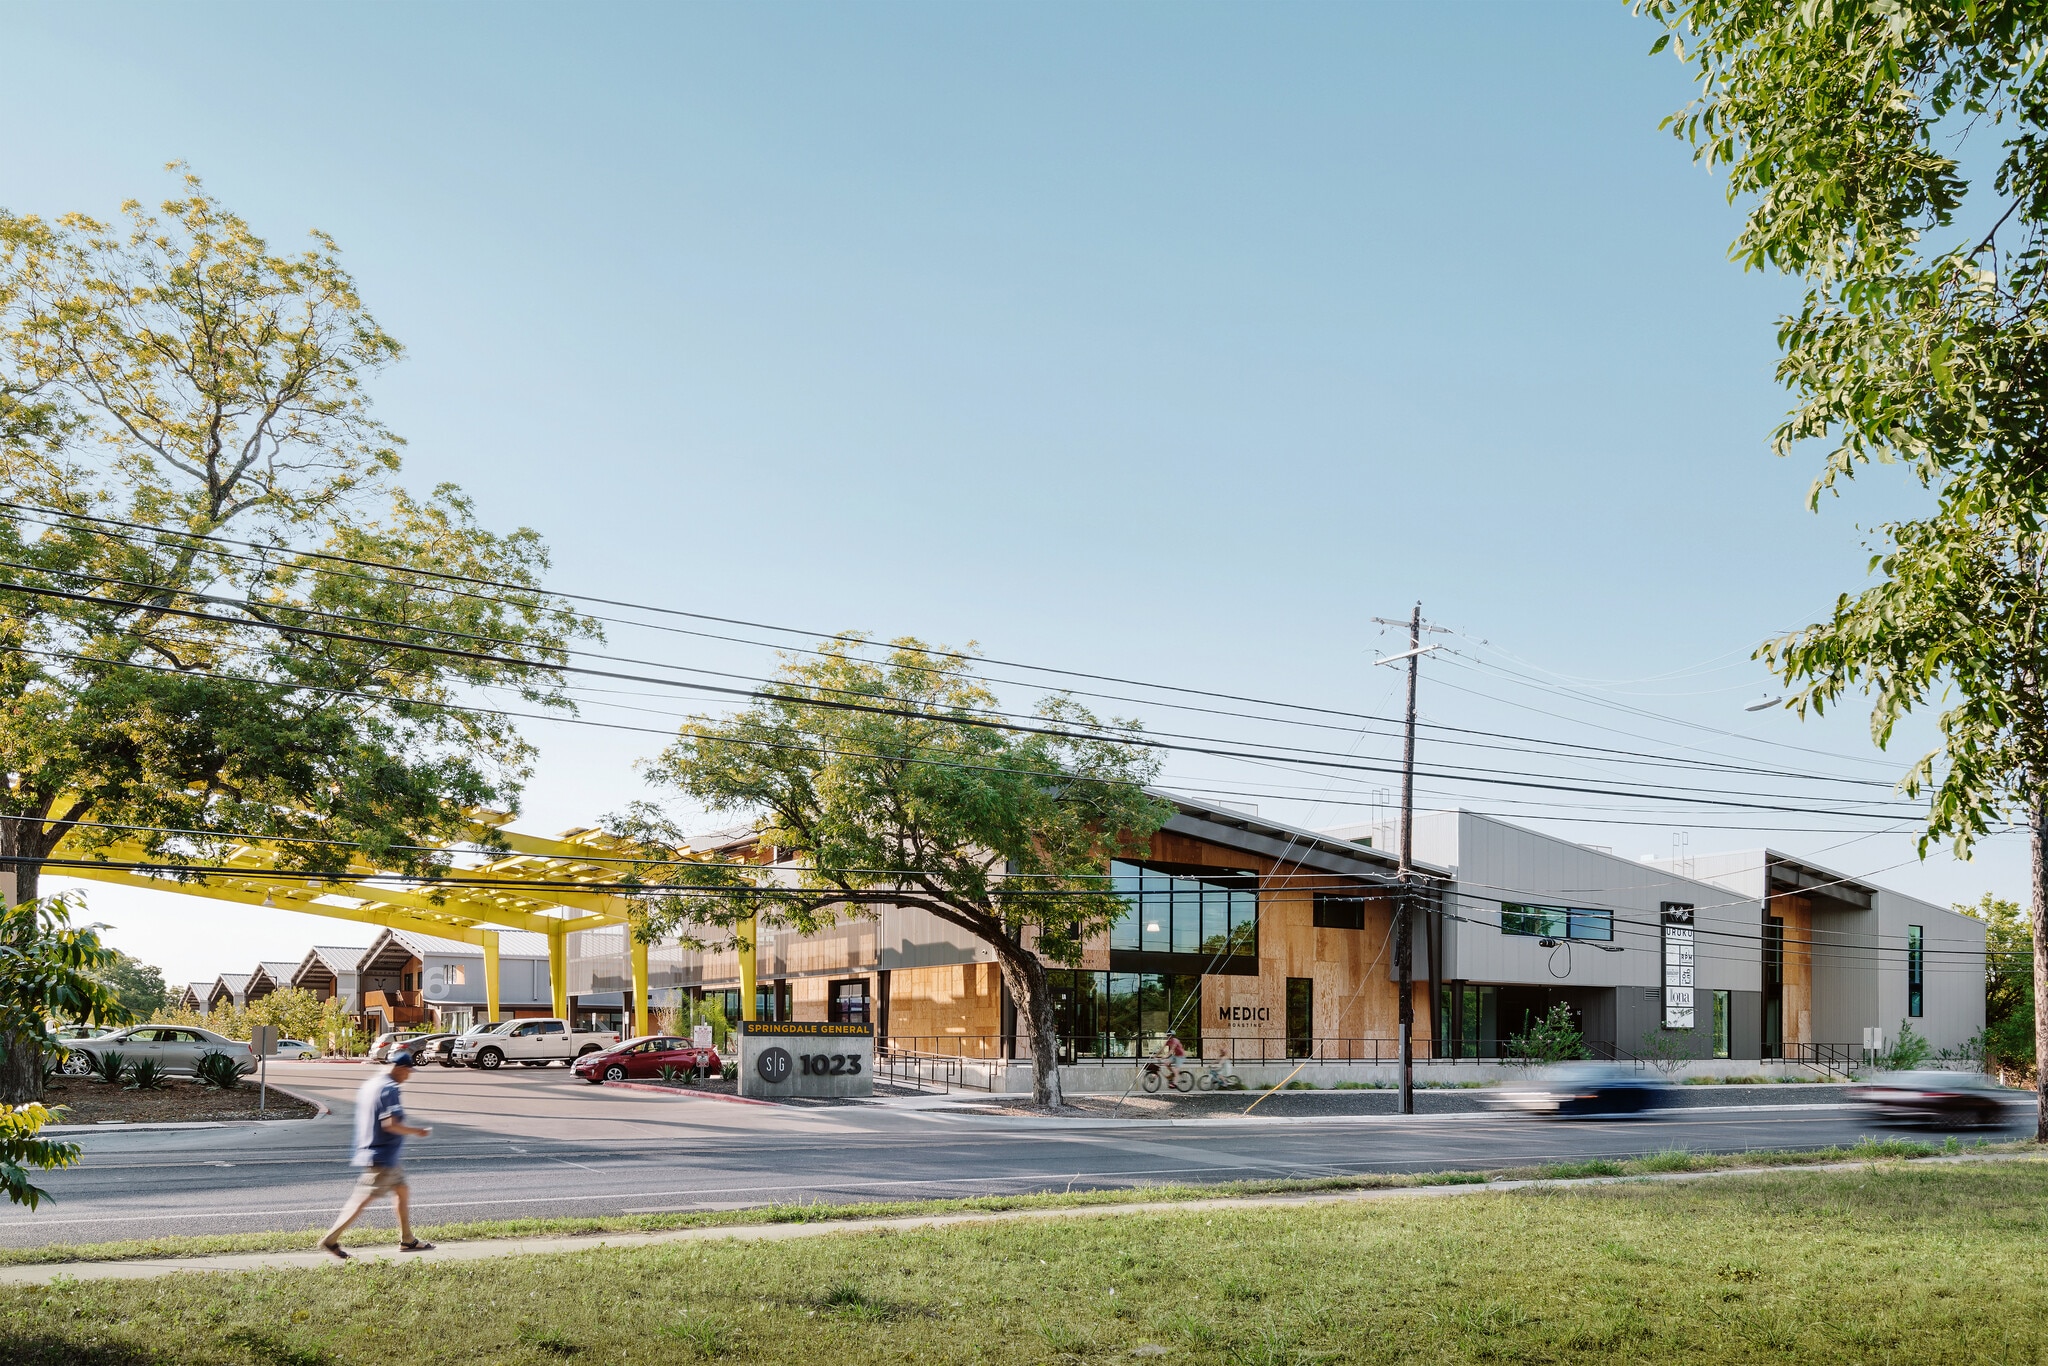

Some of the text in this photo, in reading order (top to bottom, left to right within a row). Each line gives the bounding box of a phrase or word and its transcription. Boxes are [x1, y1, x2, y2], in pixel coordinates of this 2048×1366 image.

[424, 966, 450, 1000] 6
[1219, 1006, 1270, 1021] MEDICI
[747, 1024, 870, 1034] SPRINGDALE GENERAL
[800, 1054, 862, 1076] 1023
